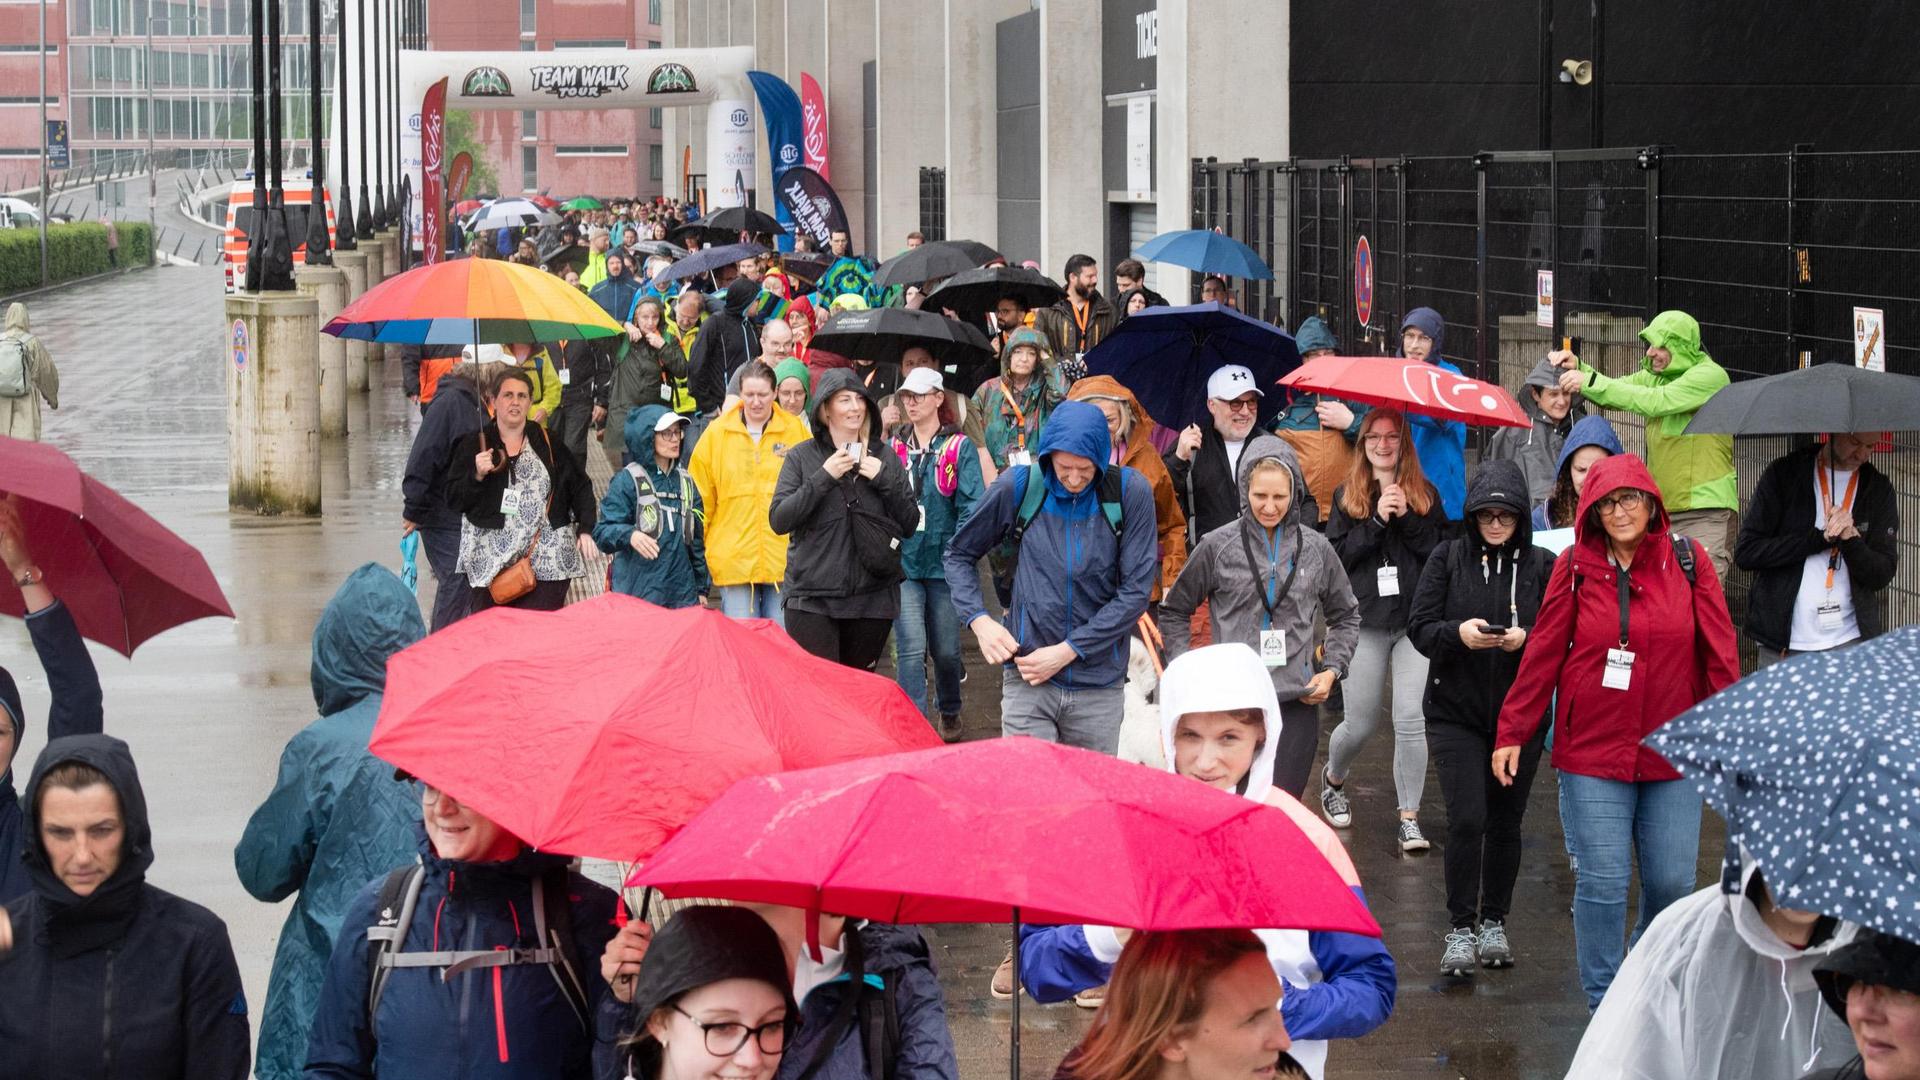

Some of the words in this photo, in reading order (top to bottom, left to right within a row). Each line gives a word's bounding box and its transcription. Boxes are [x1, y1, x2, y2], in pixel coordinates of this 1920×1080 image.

[530, 65, 578, 91] TEAM
[580, 65, 629, 91] WALK
[558, 86, 601, 98] TOUR
[730, 113, 749, 123] BIG
[780, 148, 799, 159] BIG
